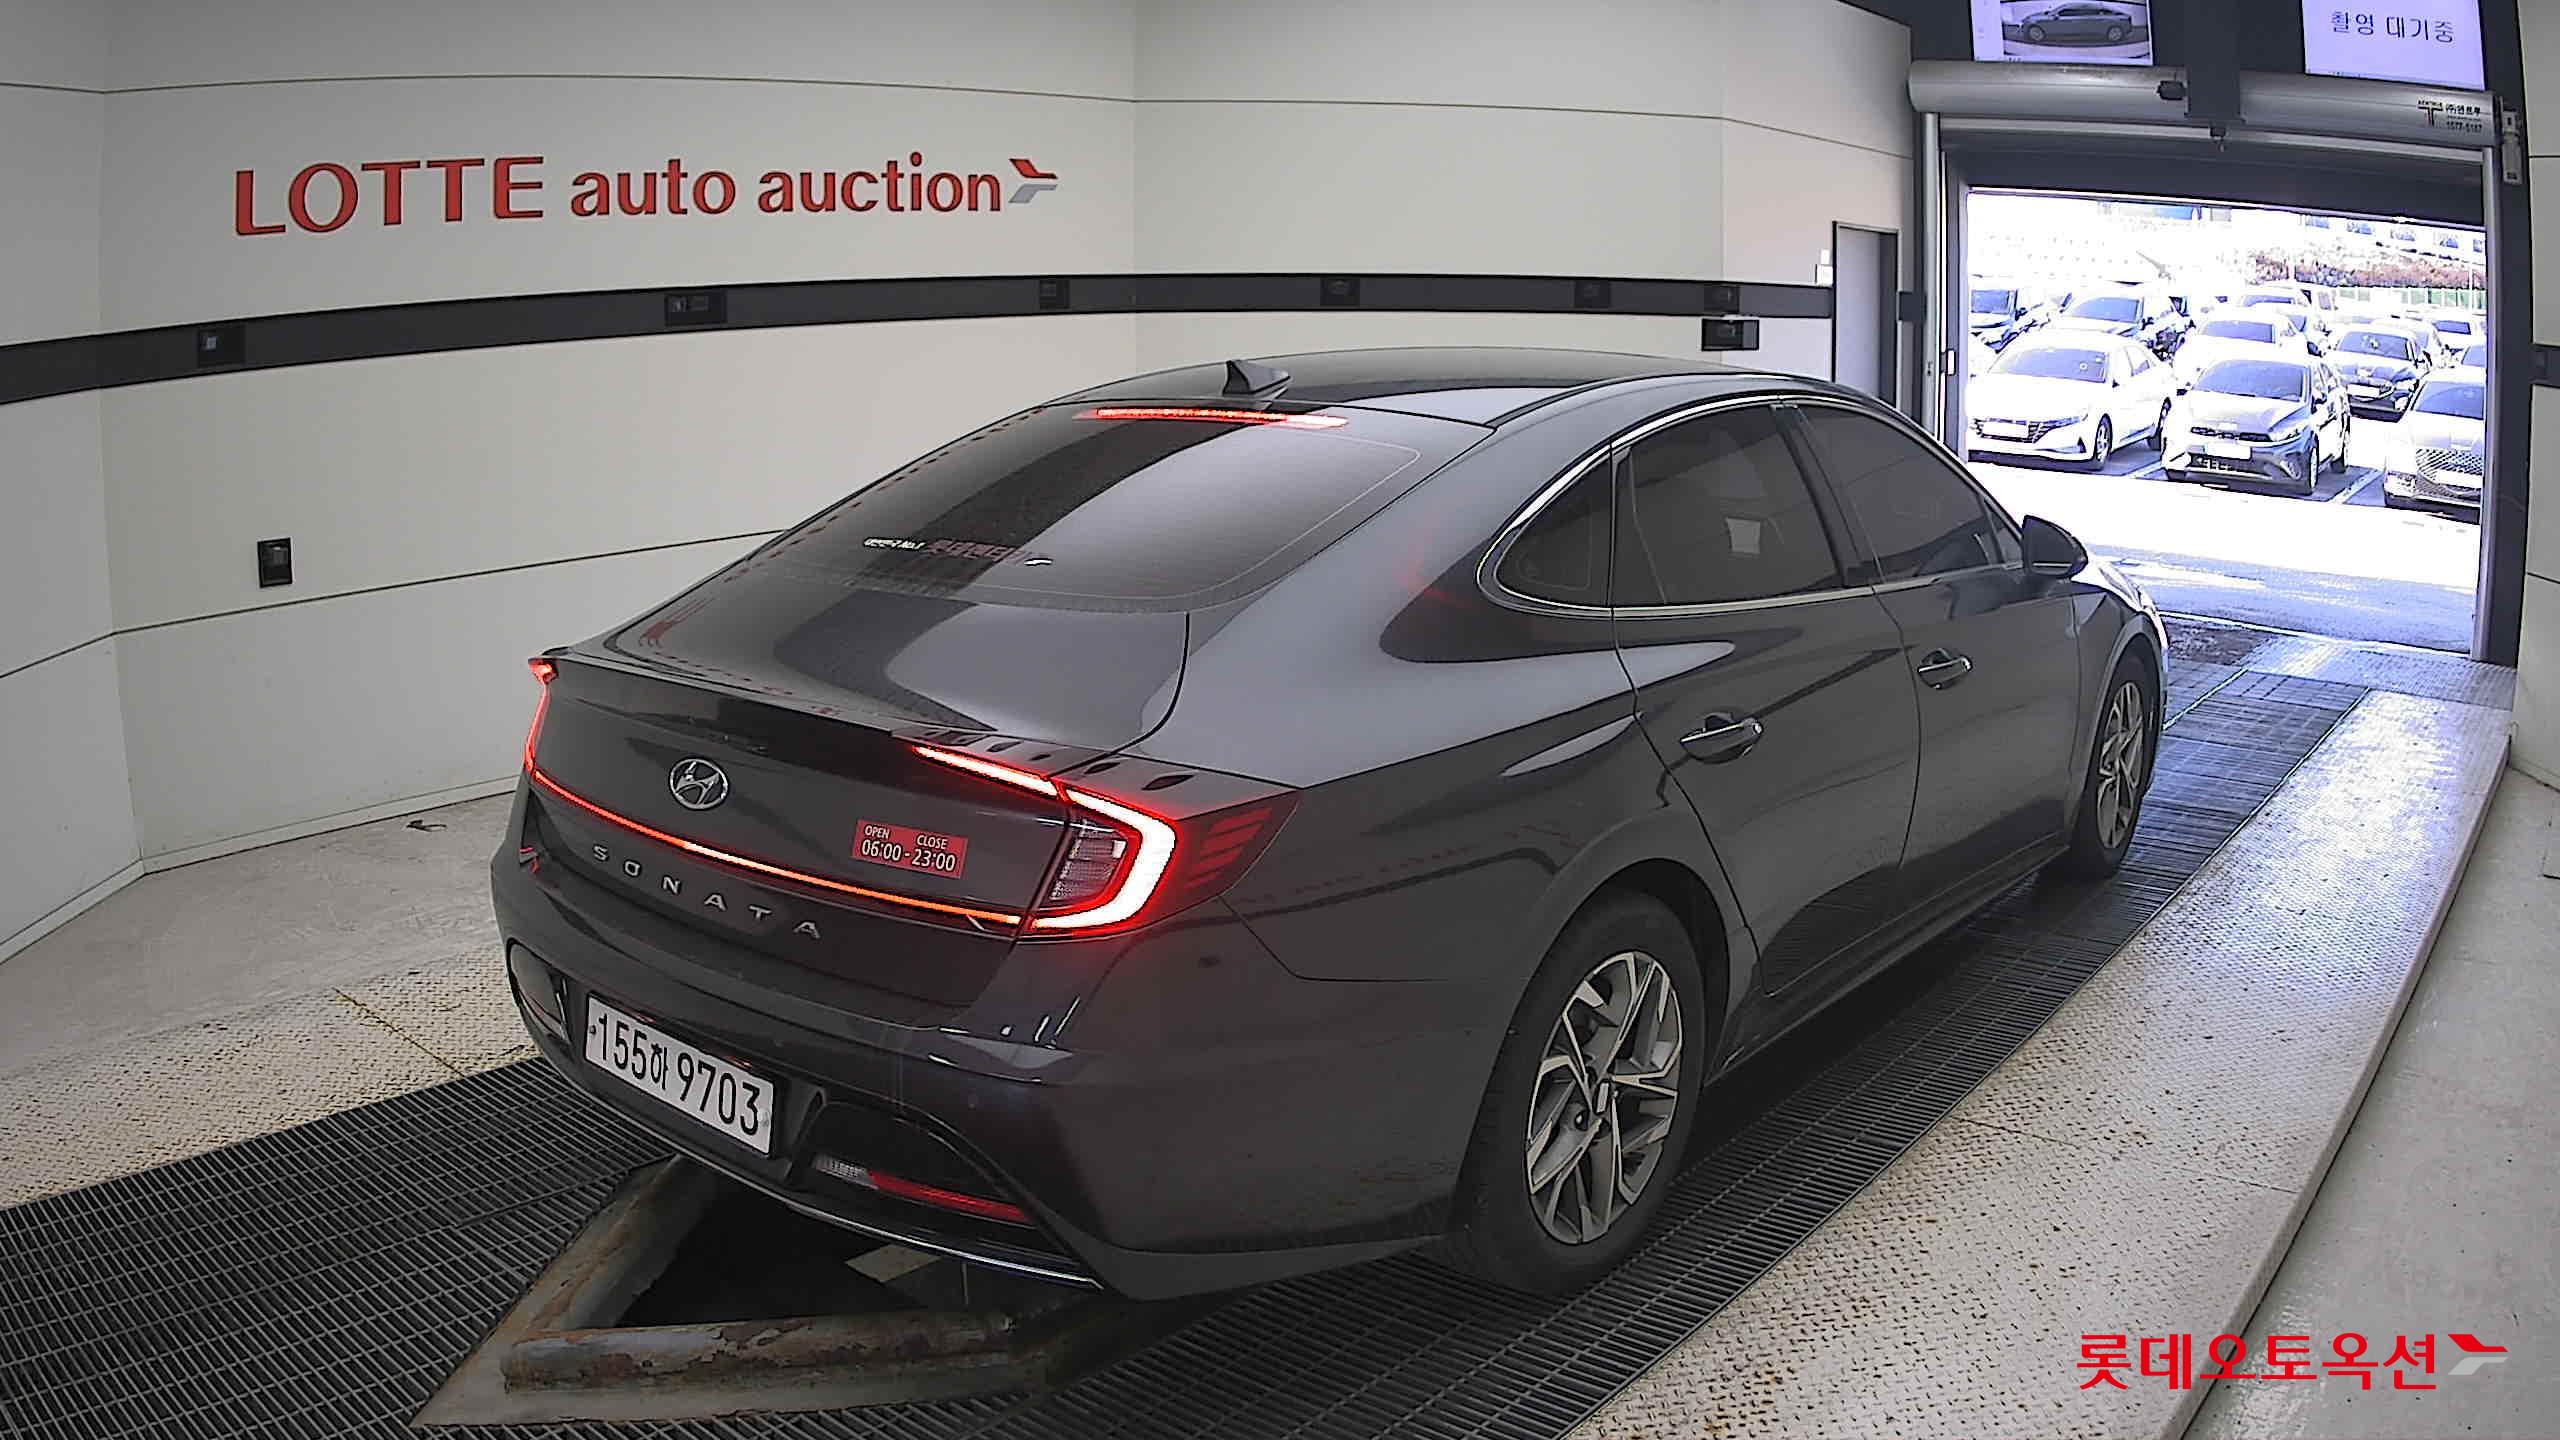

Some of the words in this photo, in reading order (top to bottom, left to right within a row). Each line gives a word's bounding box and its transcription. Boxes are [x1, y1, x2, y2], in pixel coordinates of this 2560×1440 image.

[2386, 16, 2454, 43] 대기중
[235, 156, 544, 235] LOTTE
[569, 157, 736, 216] auto
[757, 151, 1002, 213] auction
[864, 825, 890, 839] OPEN
[916, 835, 949, 849] CLOSE
[592, 845, 822, 939] SONATA
